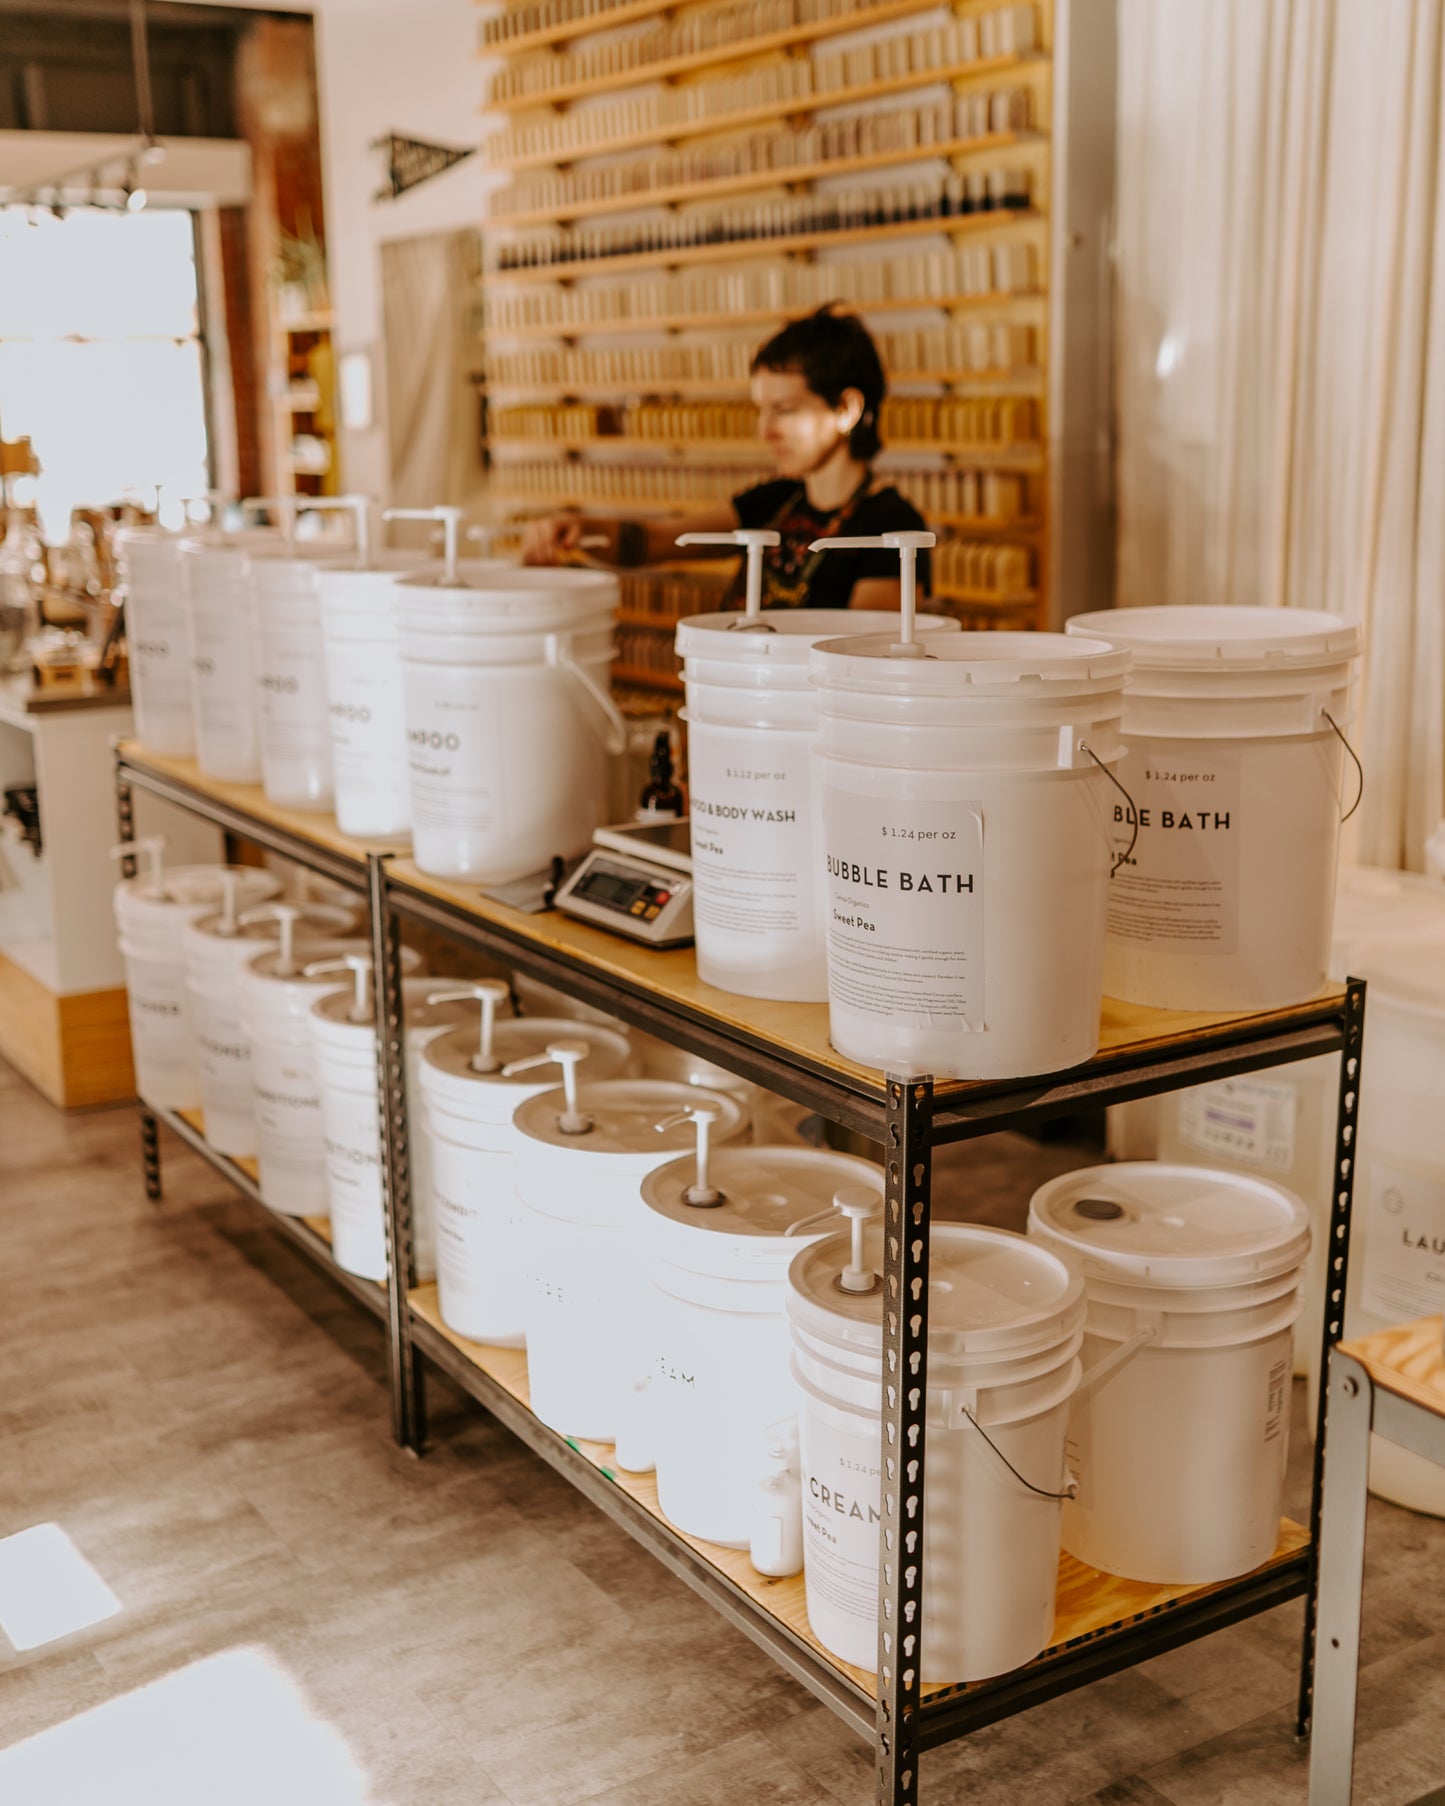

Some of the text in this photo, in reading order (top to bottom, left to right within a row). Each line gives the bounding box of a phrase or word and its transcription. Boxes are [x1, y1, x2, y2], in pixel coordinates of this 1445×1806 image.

[754, 771, 771, 780] per
[774, 772, 786, 780] oz
[1146, 770, 1216, 783] $ 1.24 per oz
[708, 803, 713, 815] &
[716, 805, 748, 820] BODY
[752, 809, 795, 822] WASH
[1162, 811, 1231, 830] BATH
[881, 826, 956, 842] $ 1.24 per oz
[827, 854, 889, 889] BUBBLE
[899, 872, 974, 893] BATH
[833, 908, 876, 932] Sweet Pea
[1401, 1229, 1445, 1255] LAU
[847, 1460, 868, 1473] 1.24
